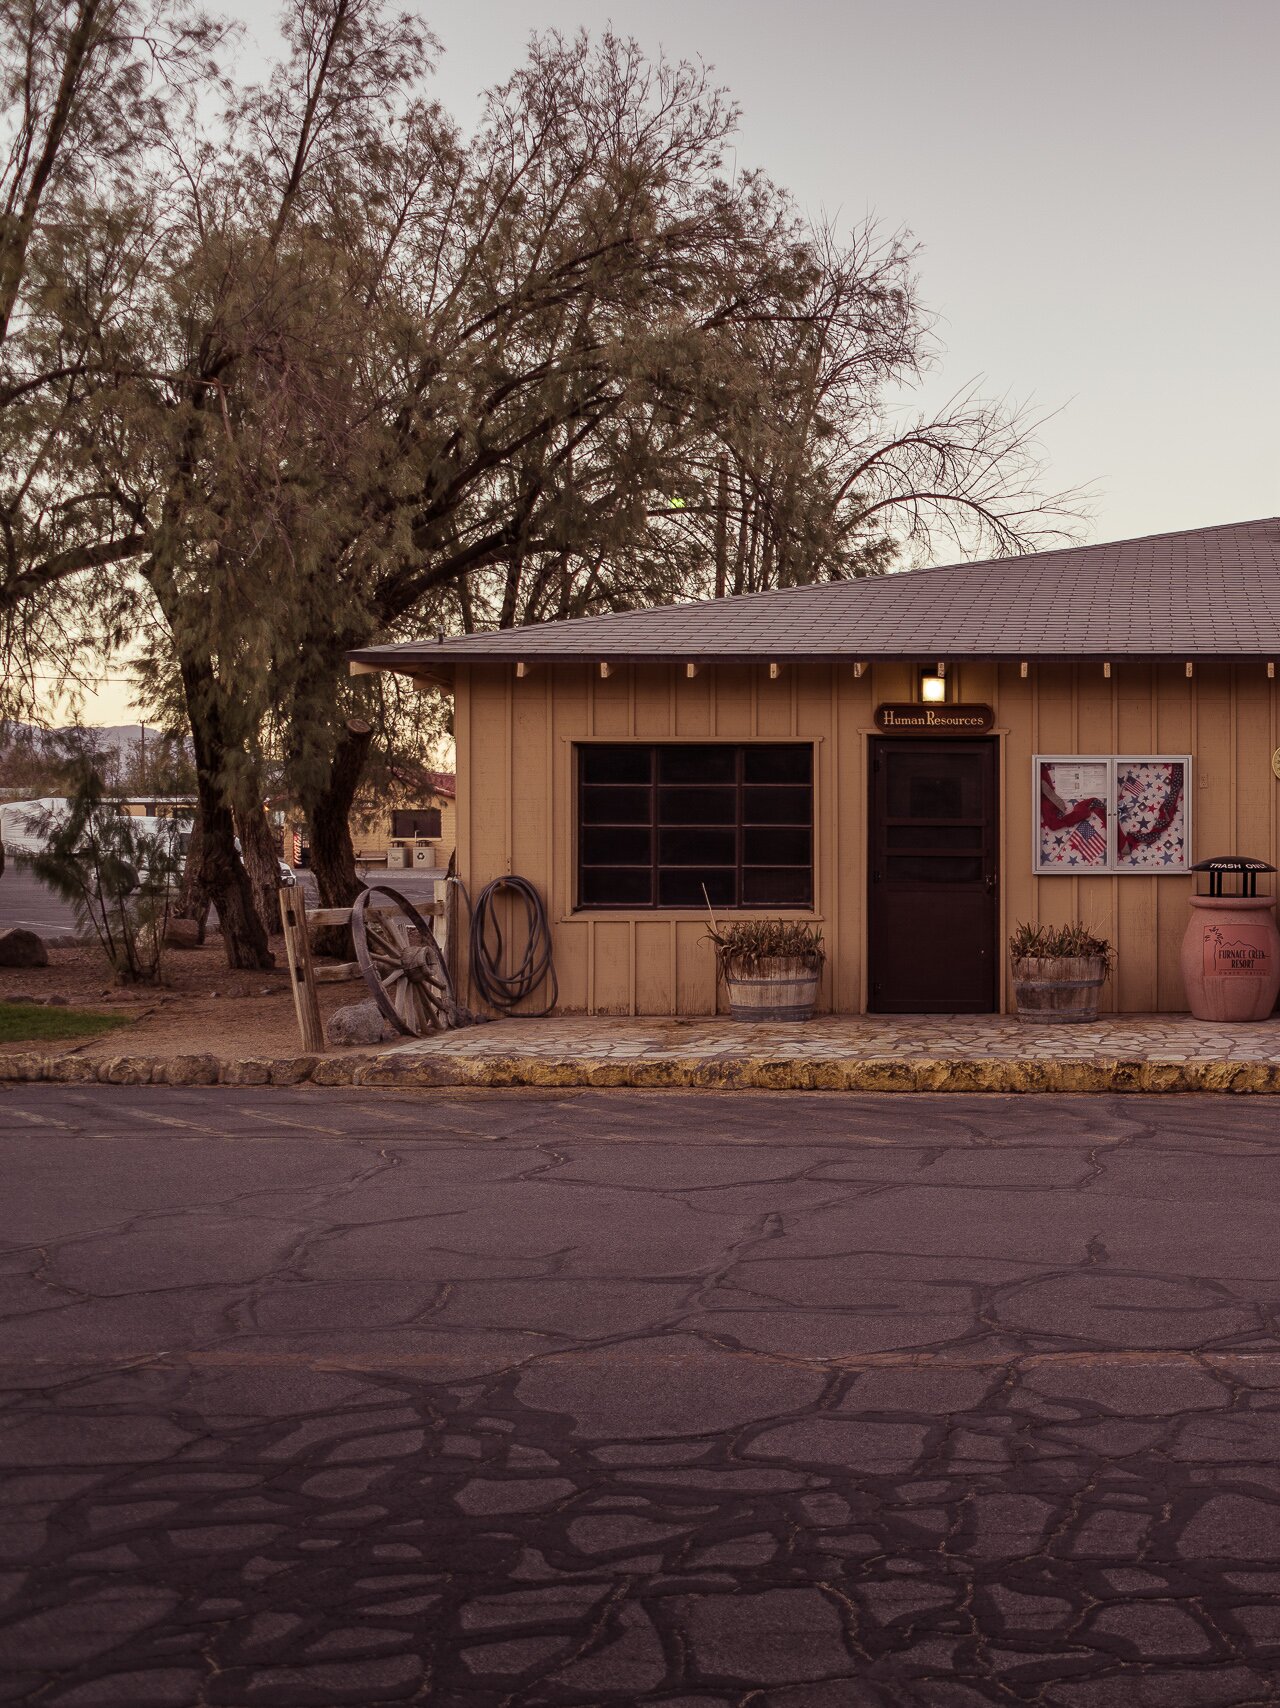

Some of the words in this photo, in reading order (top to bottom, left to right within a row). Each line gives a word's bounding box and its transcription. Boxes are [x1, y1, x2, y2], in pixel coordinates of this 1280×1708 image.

[883, 710, 925, 725] Human
[926, 710, 984, 726] Resources
[1218, 949, 1248, 960] FURNACE
[1248, 949, 1266, 960] CREEK
[1231, 959, 1255, 969] RESORT
